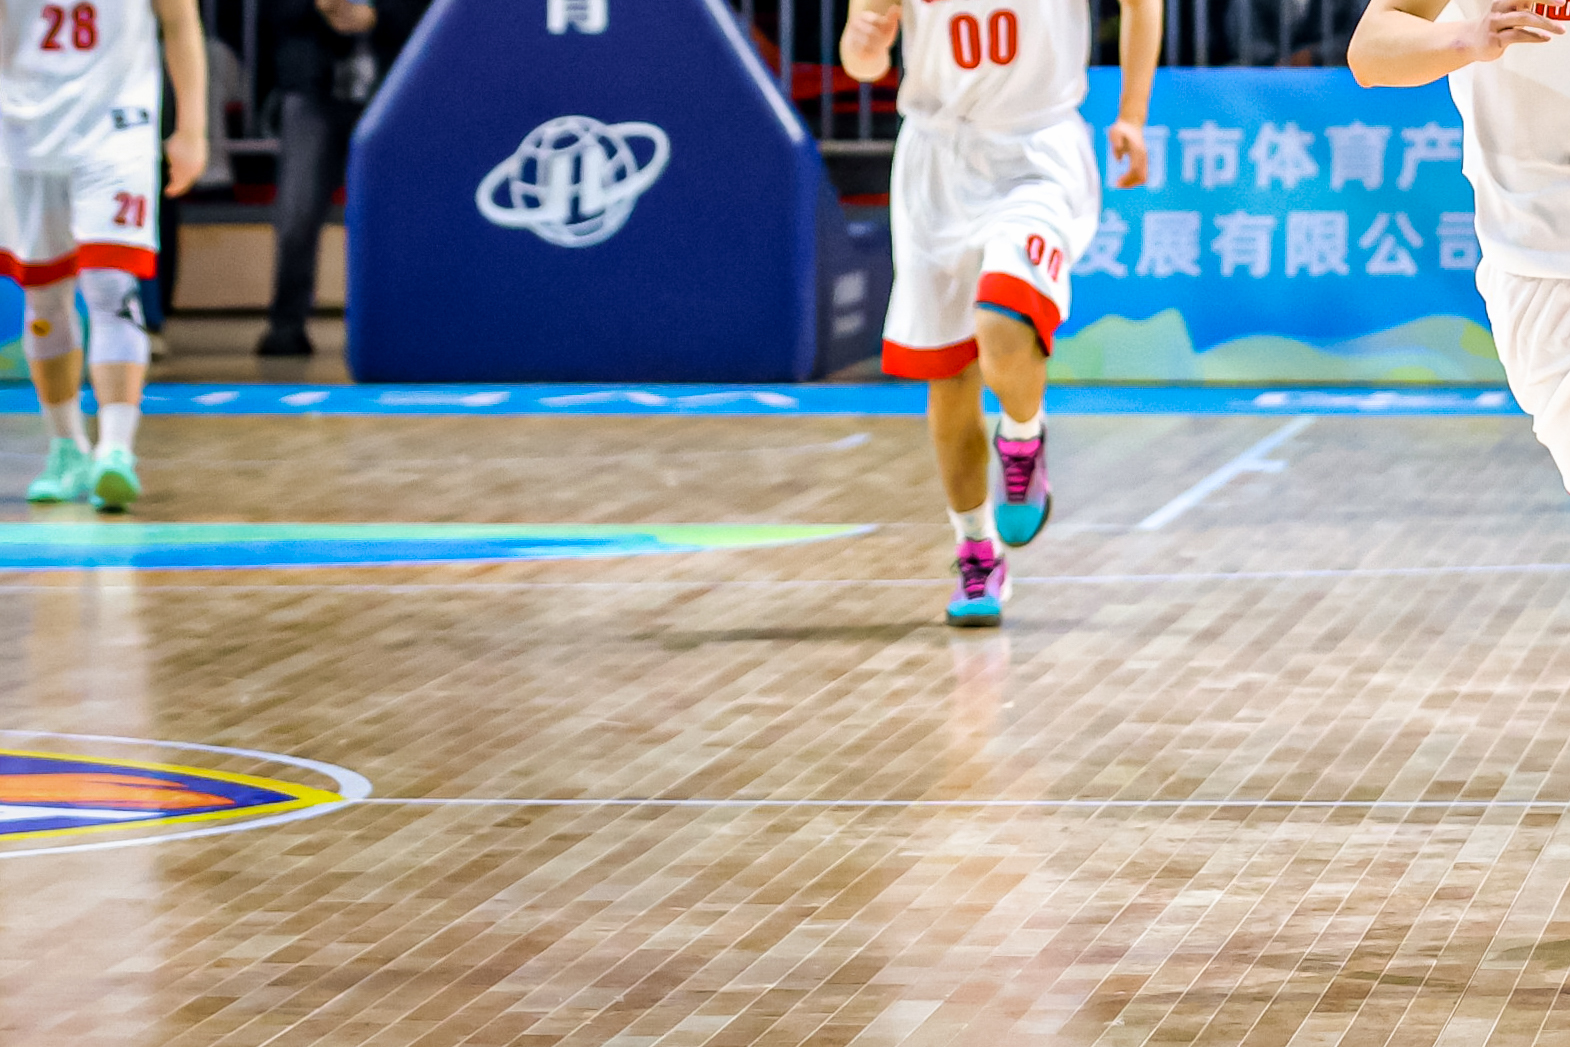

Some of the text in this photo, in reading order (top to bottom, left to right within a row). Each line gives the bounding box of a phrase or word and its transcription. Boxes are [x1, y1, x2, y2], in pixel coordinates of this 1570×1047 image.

[40, 2, 98, 51] 28
[951, 9, 1017, 69] 00
[1026, 233, 1063, 283] 00
